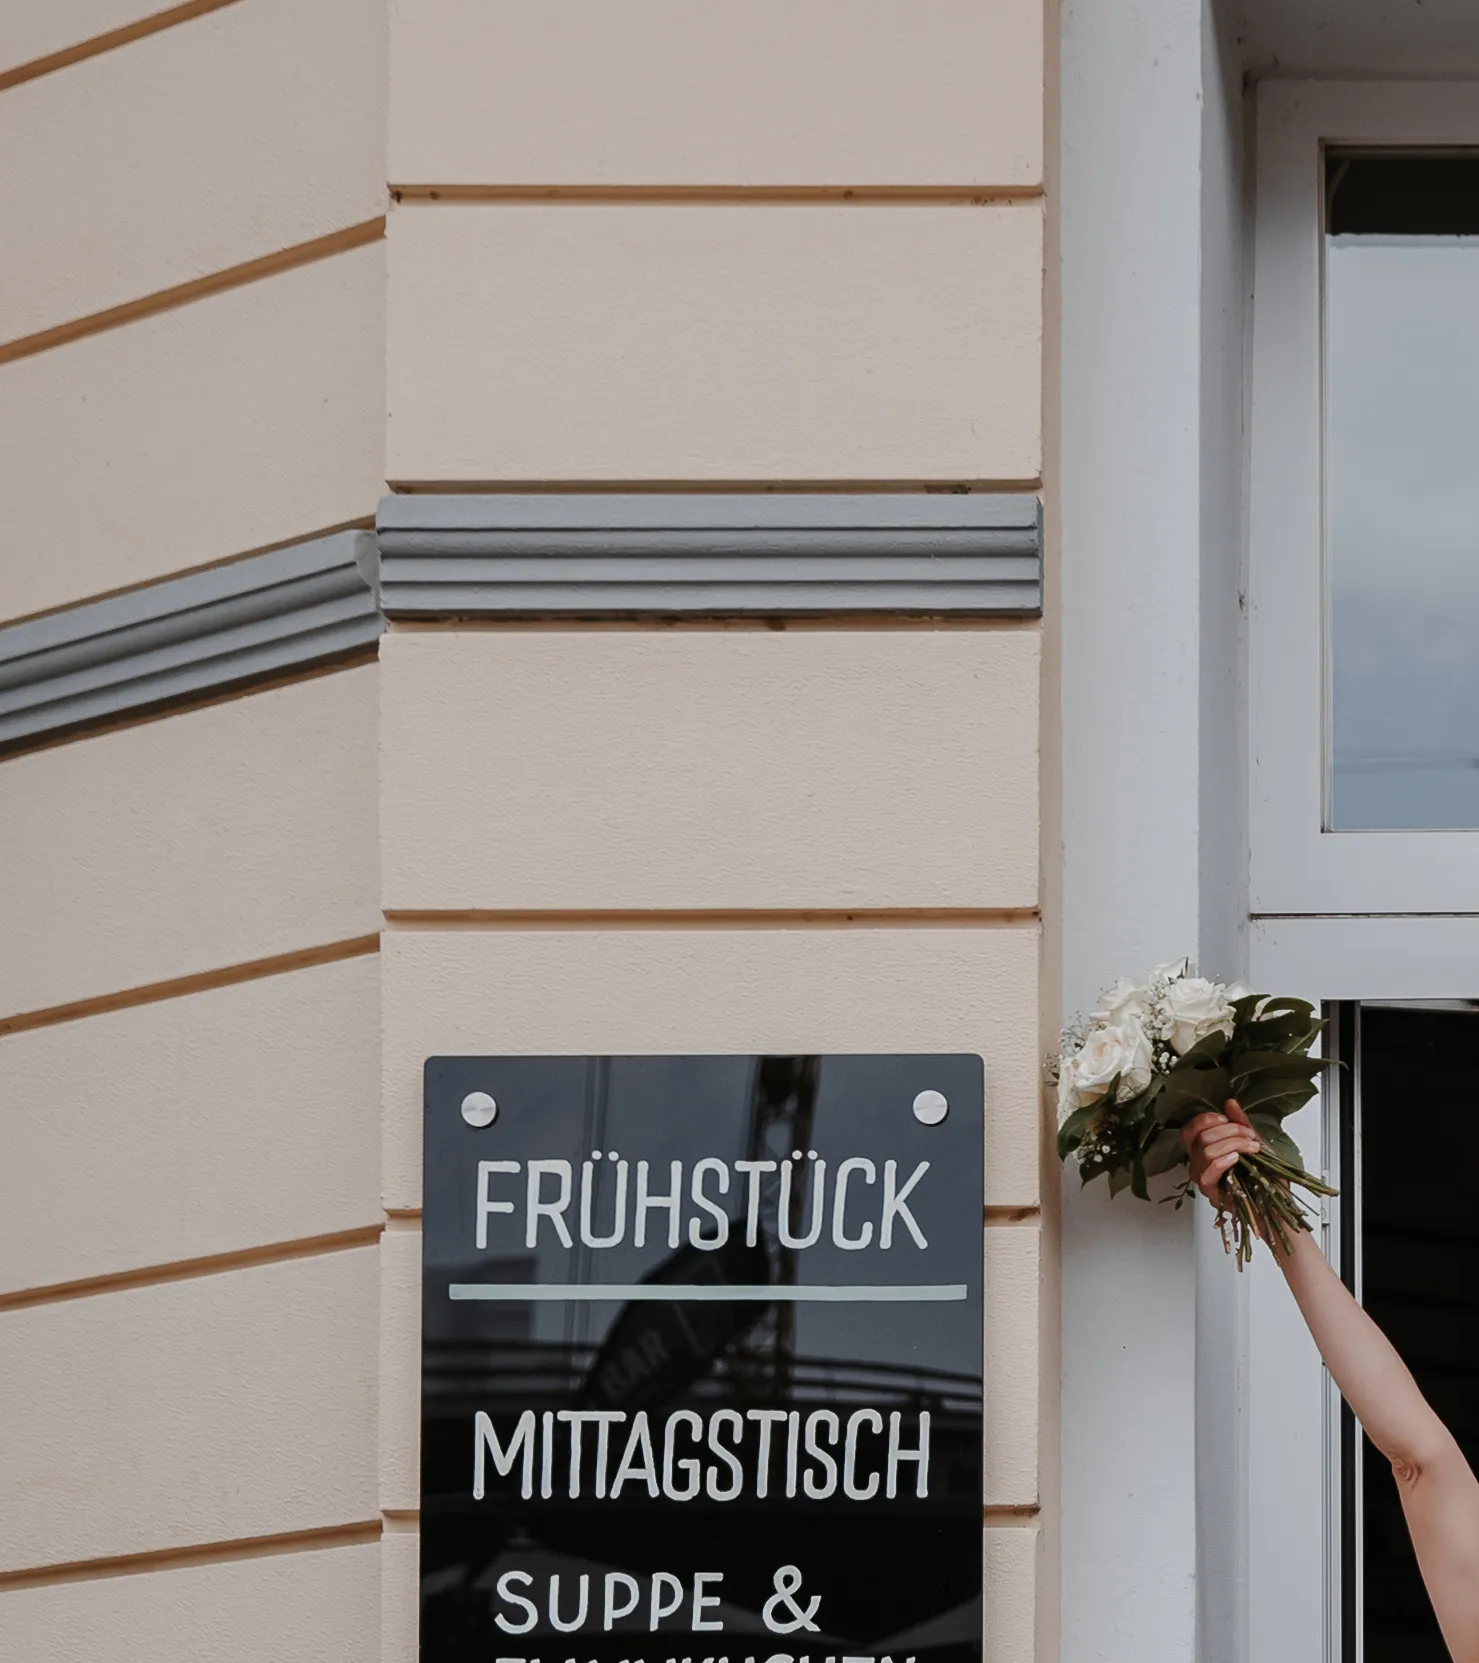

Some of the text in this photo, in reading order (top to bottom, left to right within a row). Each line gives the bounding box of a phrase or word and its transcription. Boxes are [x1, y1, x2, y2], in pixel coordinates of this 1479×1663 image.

[474, 1149, 931, 1251] FRÜHSTÜCK
[472, 1408, 931, 1502] MITTAGSTISCH
[493, 1564, 822, 1635] SUPPE &
